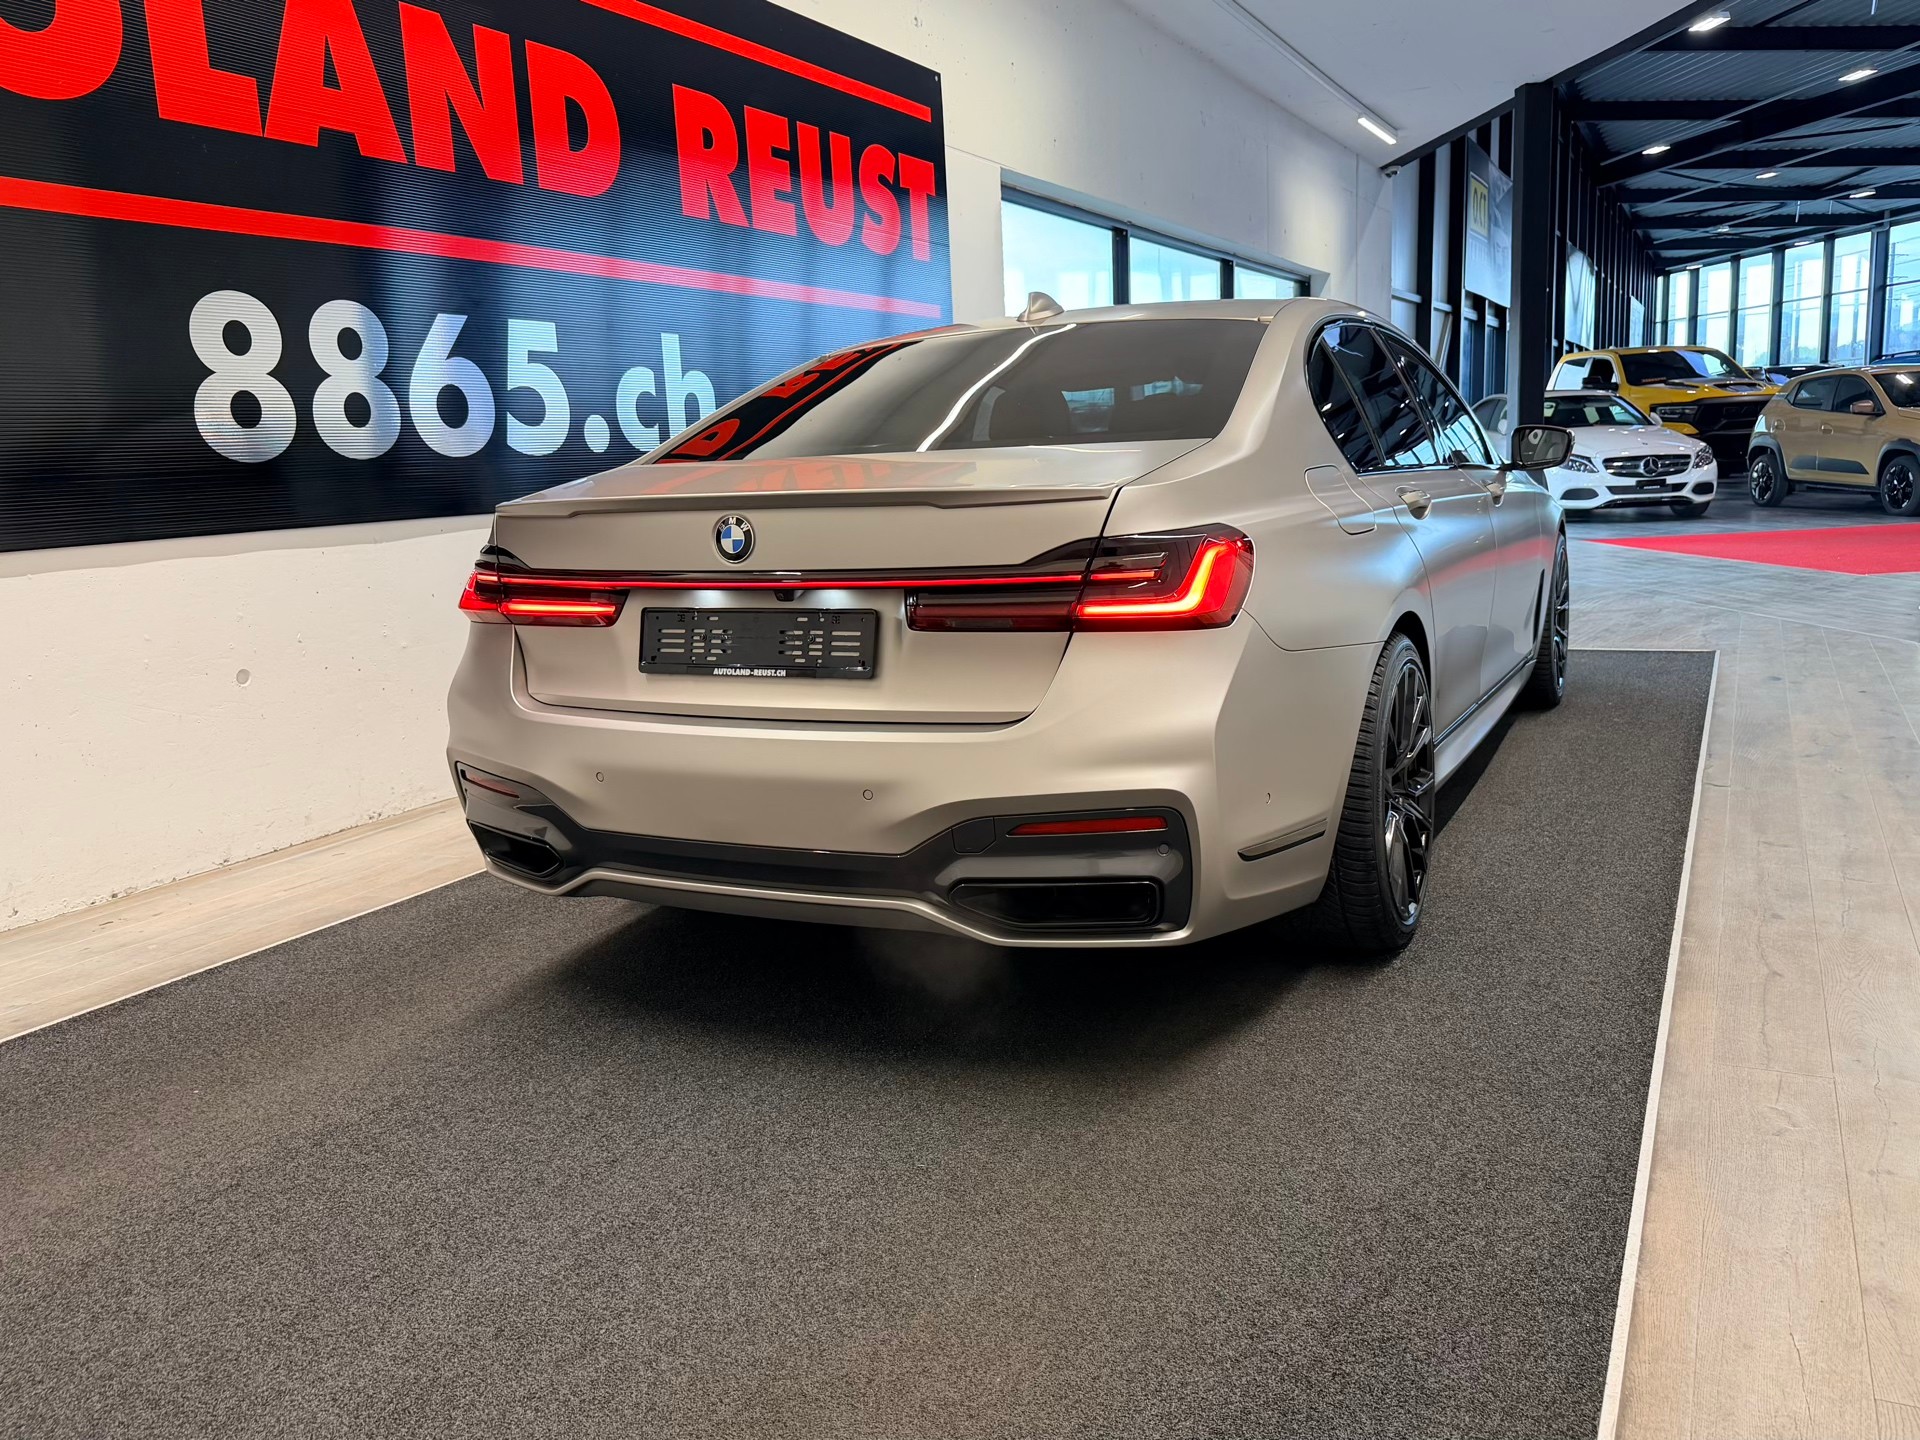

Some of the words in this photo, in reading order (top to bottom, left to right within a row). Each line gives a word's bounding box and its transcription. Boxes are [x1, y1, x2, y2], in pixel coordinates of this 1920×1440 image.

[672, 83, 936, 263] REUST
[189, 289, 717, 464] 8865.ch
[718, 516, 751, 532] BMW
[713, 667, 787, 677] AUTOLAND-REUST.CH
